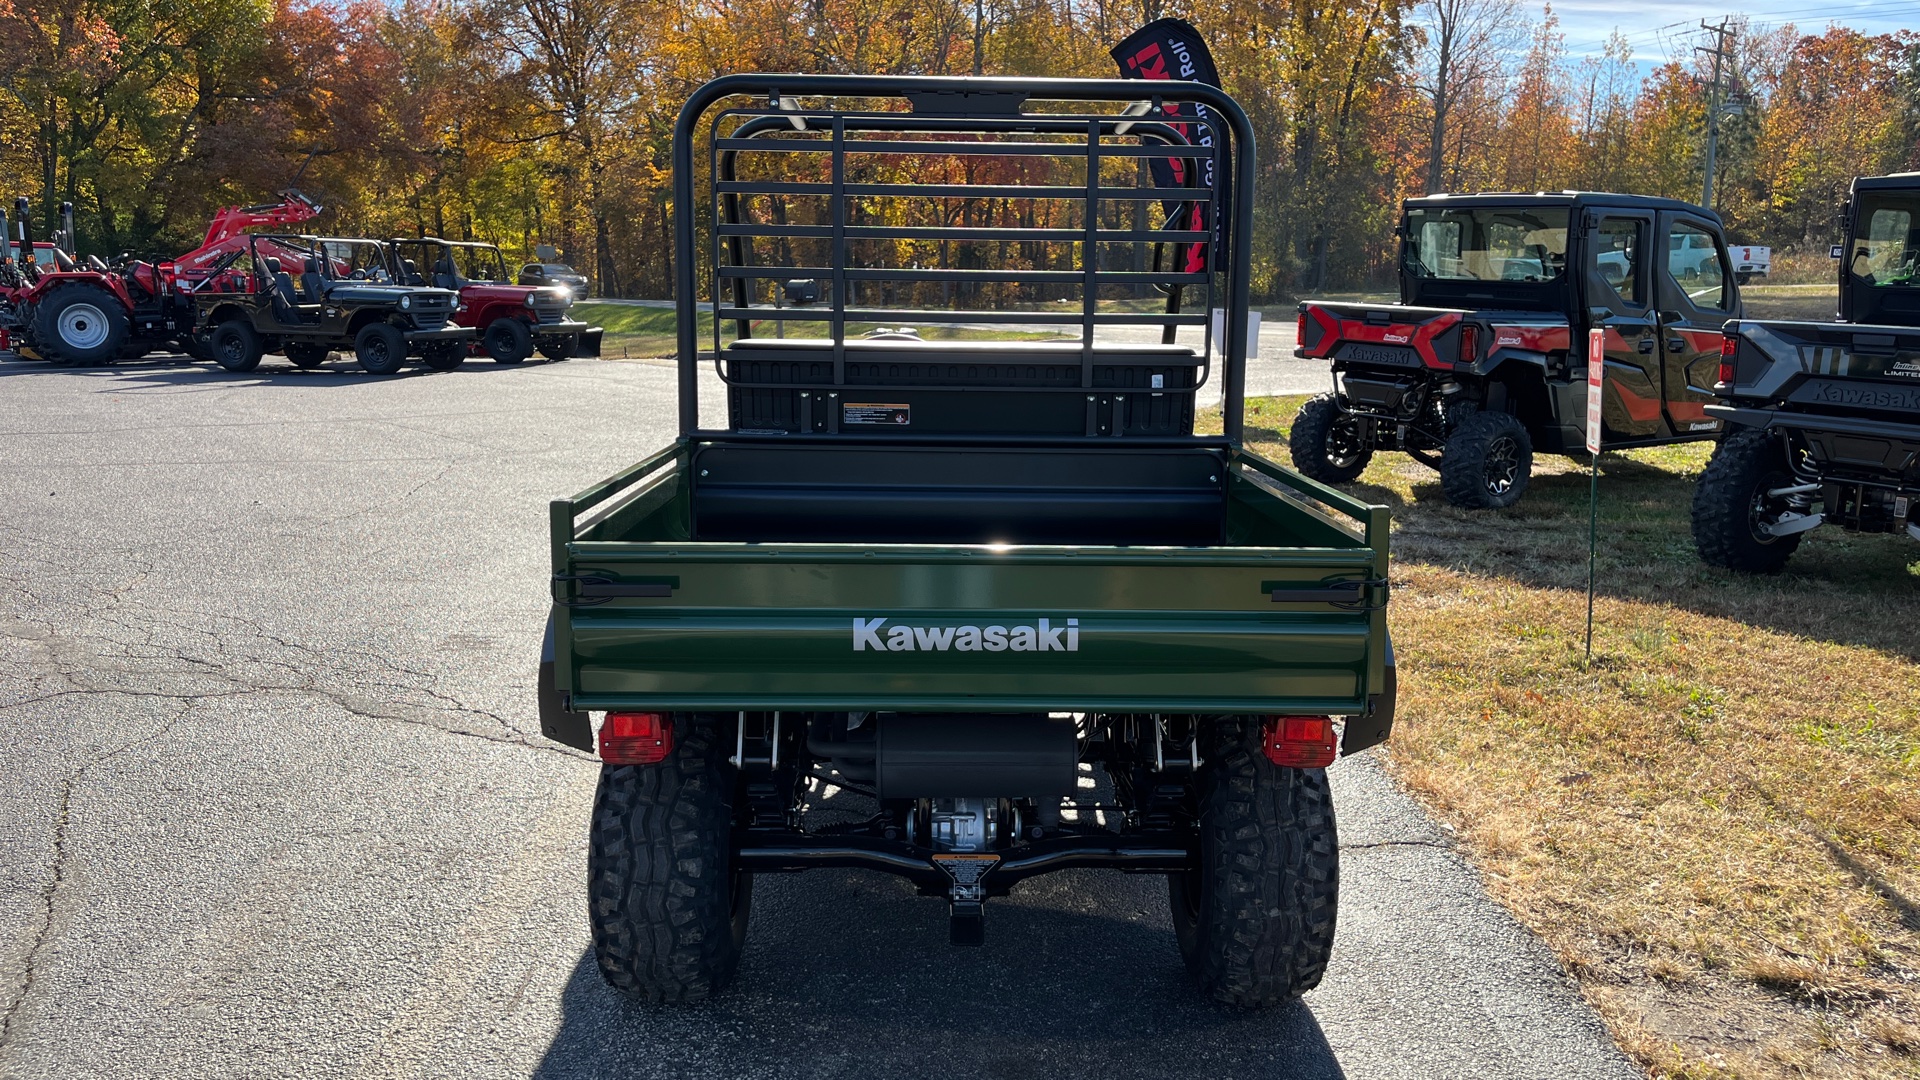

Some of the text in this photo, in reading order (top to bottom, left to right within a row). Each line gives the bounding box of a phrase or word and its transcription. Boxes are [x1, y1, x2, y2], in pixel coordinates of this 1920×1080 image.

[1199, 136, 1213, 186] God
[1347, 347, 1410, 365] Kawasaki
[1892, 361, 1920, 371] Inline
[1689, 420, 1718, 431] Kawasaki
[853, 617, 1079, 652] Kawasaki
